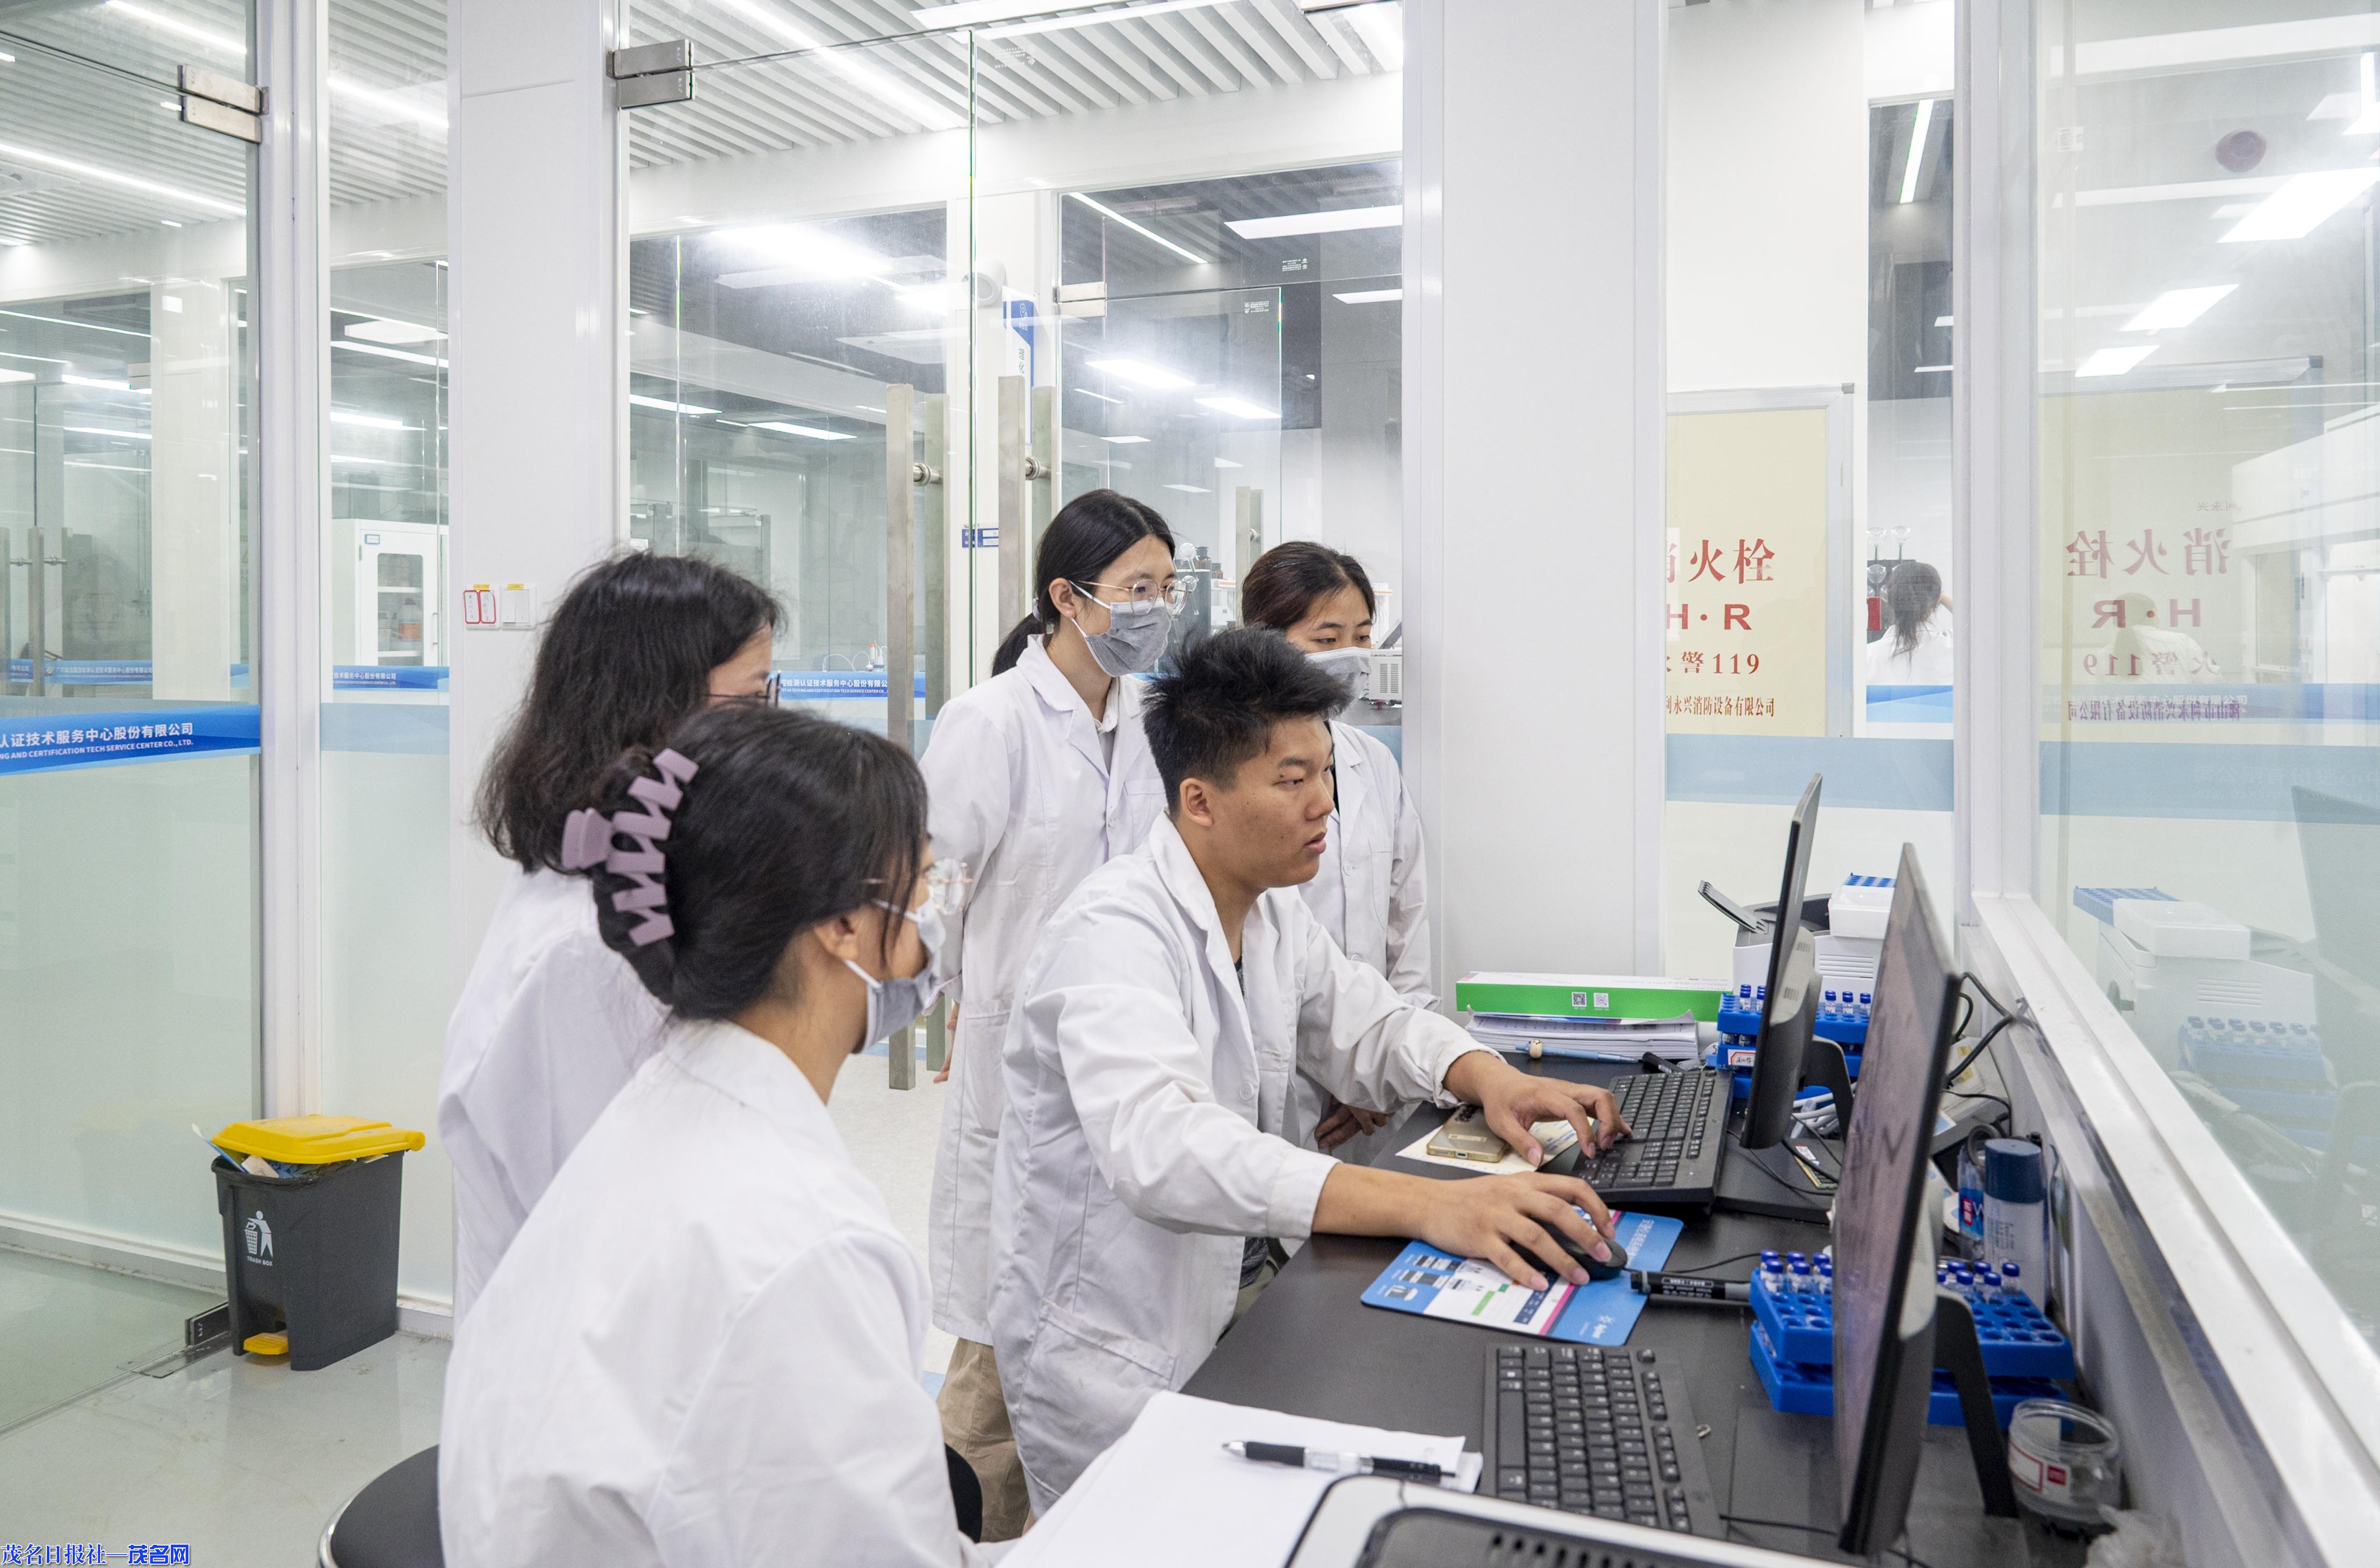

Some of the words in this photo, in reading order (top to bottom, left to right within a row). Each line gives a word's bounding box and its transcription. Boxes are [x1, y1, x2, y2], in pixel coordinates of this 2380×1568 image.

[1667, 651, 1759, 674] 警119
[28, 747, 85, 758] CERTIFICATION
[86, 745, 105, 753] TECH
[106, 743, 135, 752] SERVICE
[136, 742, 163, 750] CENTER
[247, 1255, 262, 1264] TRASH
